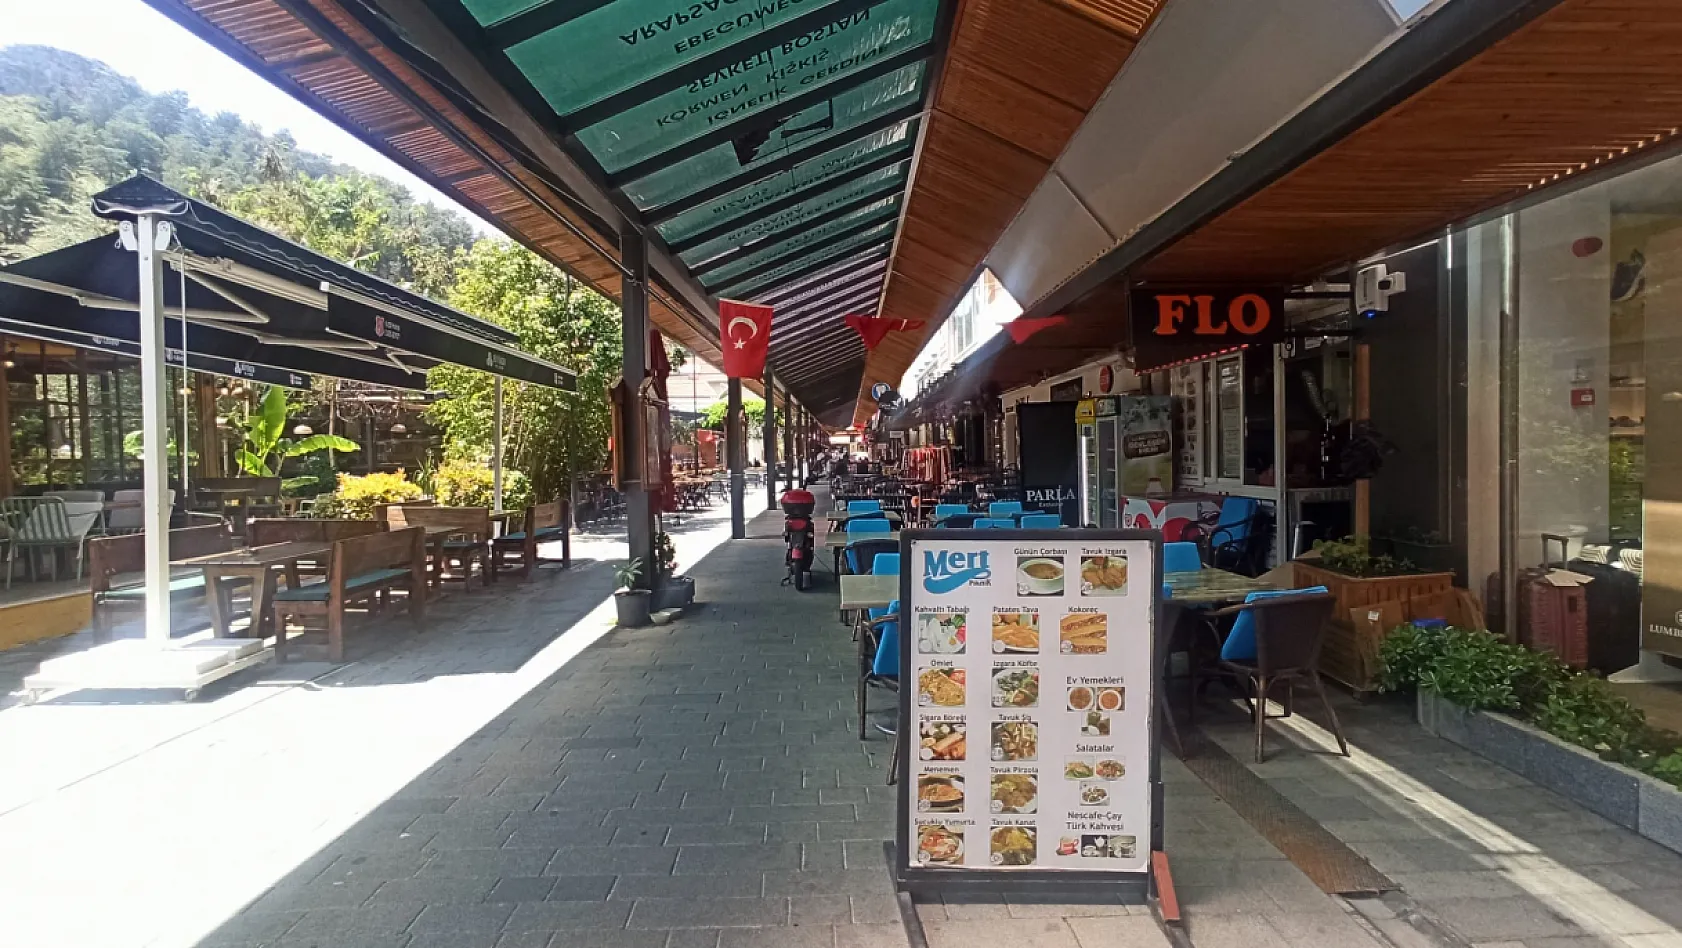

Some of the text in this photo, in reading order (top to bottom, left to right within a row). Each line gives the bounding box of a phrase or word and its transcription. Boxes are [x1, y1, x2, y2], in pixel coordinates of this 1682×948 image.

[1153, 293, 1271, 335] FLO
[1025, 487, 1076, 502] PARLA
[1081, 547, 1102, 555] Tavuk
[923, 550, 990, 577] Mert
[993, 605, 1039, 613] Patates Tava
[1068, 605, 1099, 614] Kokoreç
[1066, 675, 1125, 685] Ev Yemekleri
[998, 714, 1020, 722] Tavuk
[1075, 743, 1115, 753] Salatalar
[924, 765, 960, 773] Menemen
[990, 766, 1039, 774] Tavuk Pirzola
[992, 818, 1036, 826] Tavuk Kanat
[1066, 821, 1087, 830] Türk
